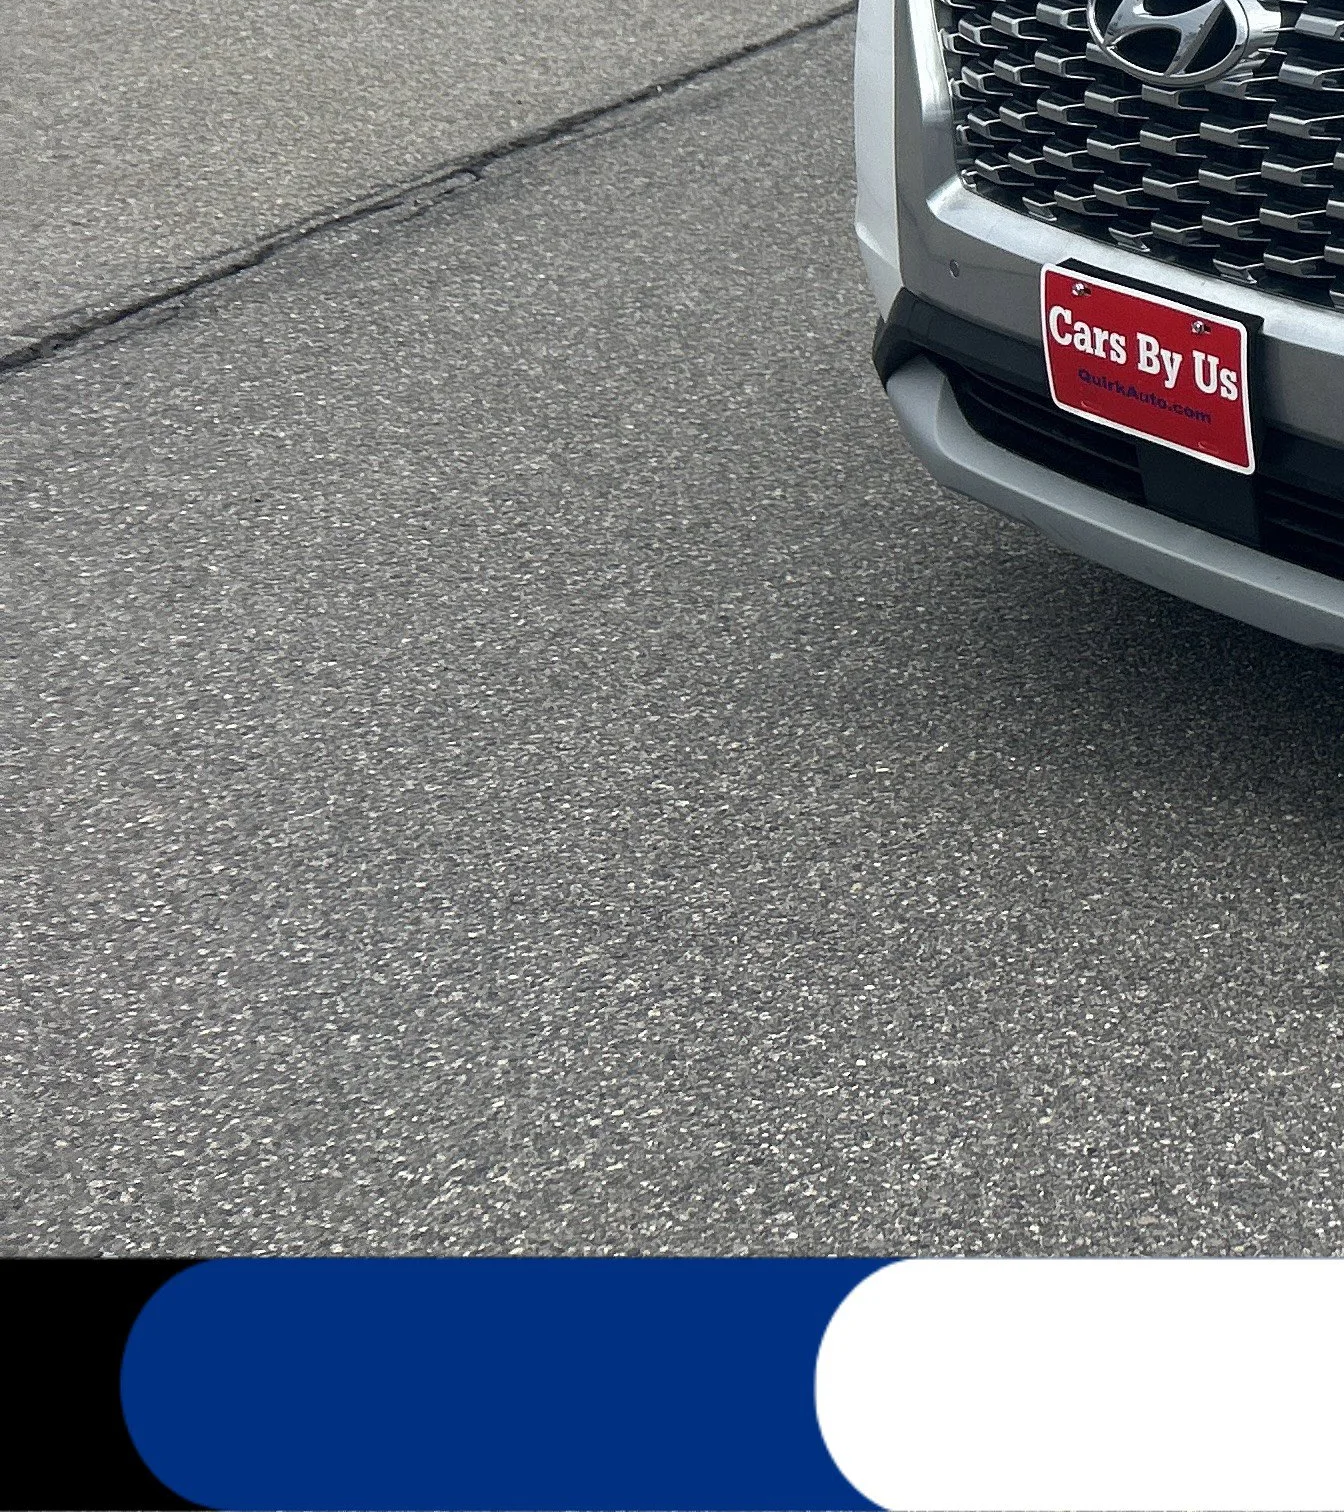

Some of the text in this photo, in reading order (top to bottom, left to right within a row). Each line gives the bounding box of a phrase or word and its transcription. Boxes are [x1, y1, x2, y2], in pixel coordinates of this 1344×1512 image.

[1048, 305, 1239, 402] Cars By Us
[1077, 367, 1212, 424] QuirkAuto.com
